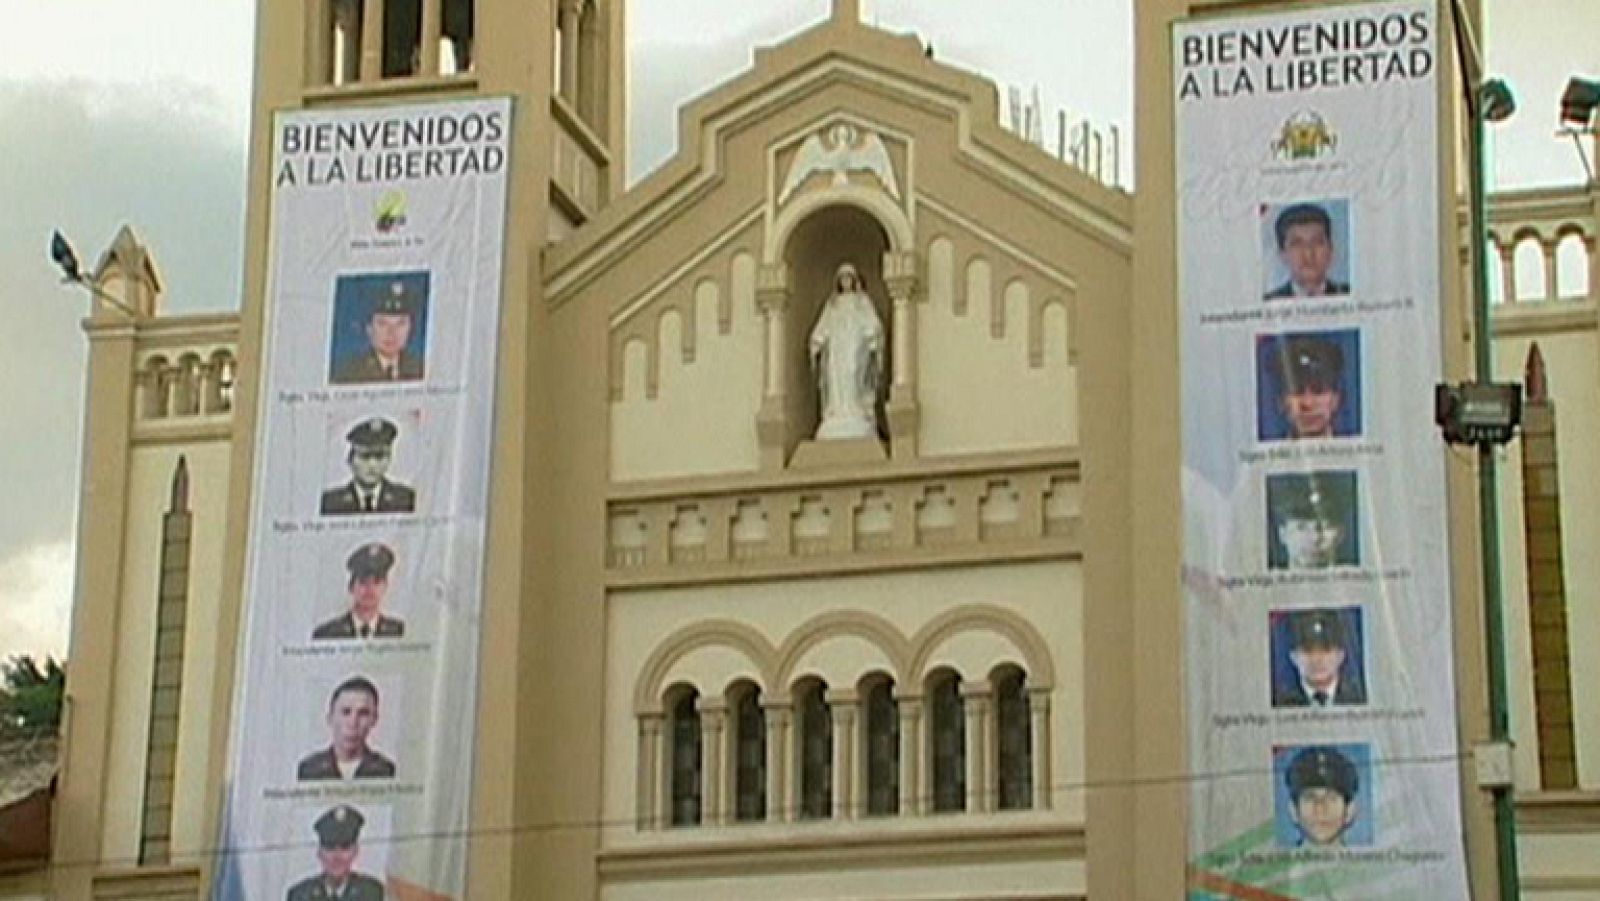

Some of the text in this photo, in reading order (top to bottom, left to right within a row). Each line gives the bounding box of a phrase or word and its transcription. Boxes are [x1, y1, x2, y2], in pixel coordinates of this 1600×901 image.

[1183, 12, 1428, 66] BIENVENIDOS
[1180, 50, 1432, 99] A LA LIBERTAD
[283, 112, 502, 152] BIENVENIDOS
[277, 147, 503, 187] A LA LIBERTAD
